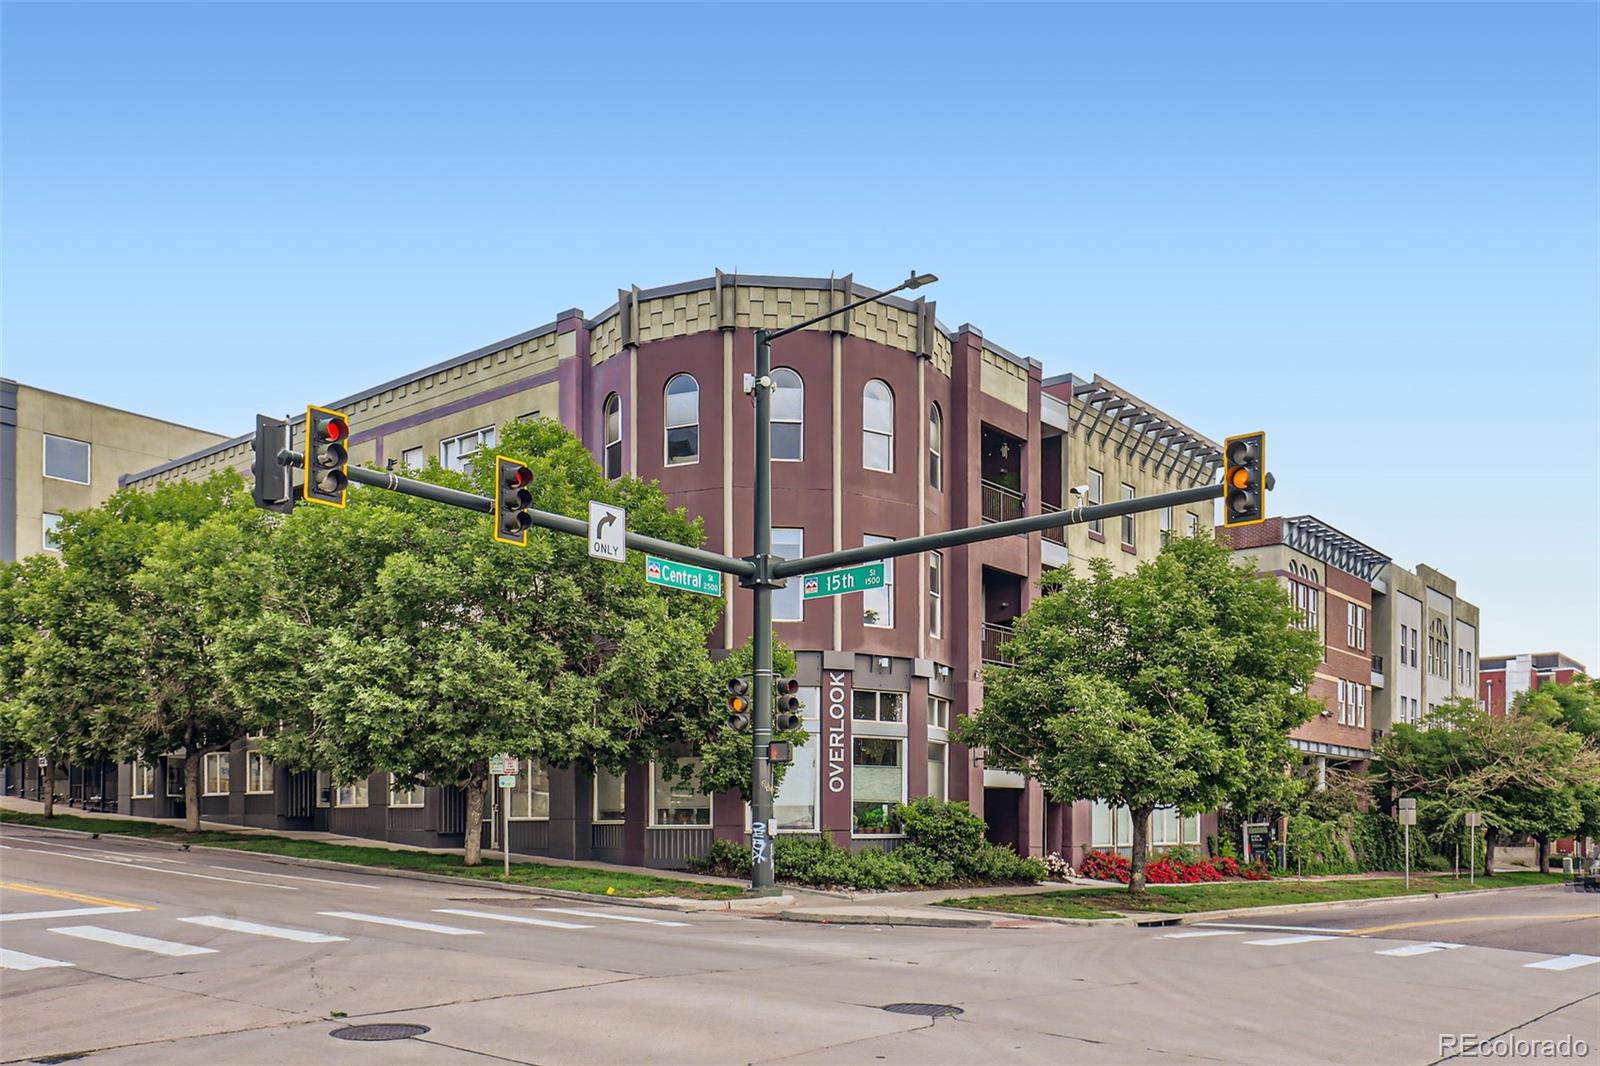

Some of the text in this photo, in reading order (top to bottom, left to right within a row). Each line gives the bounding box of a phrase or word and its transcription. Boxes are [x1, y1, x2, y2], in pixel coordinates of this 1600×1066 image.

[594, 541, 619, 556] ONLY
[661, 565, 714, 588] Central St
[827, 568, 876, 591] 15th St
[864, 576, 881, 585] 1500
[703, 582, 719, 592] 2500
[829, 671, 845, 793] OVERLOOK
